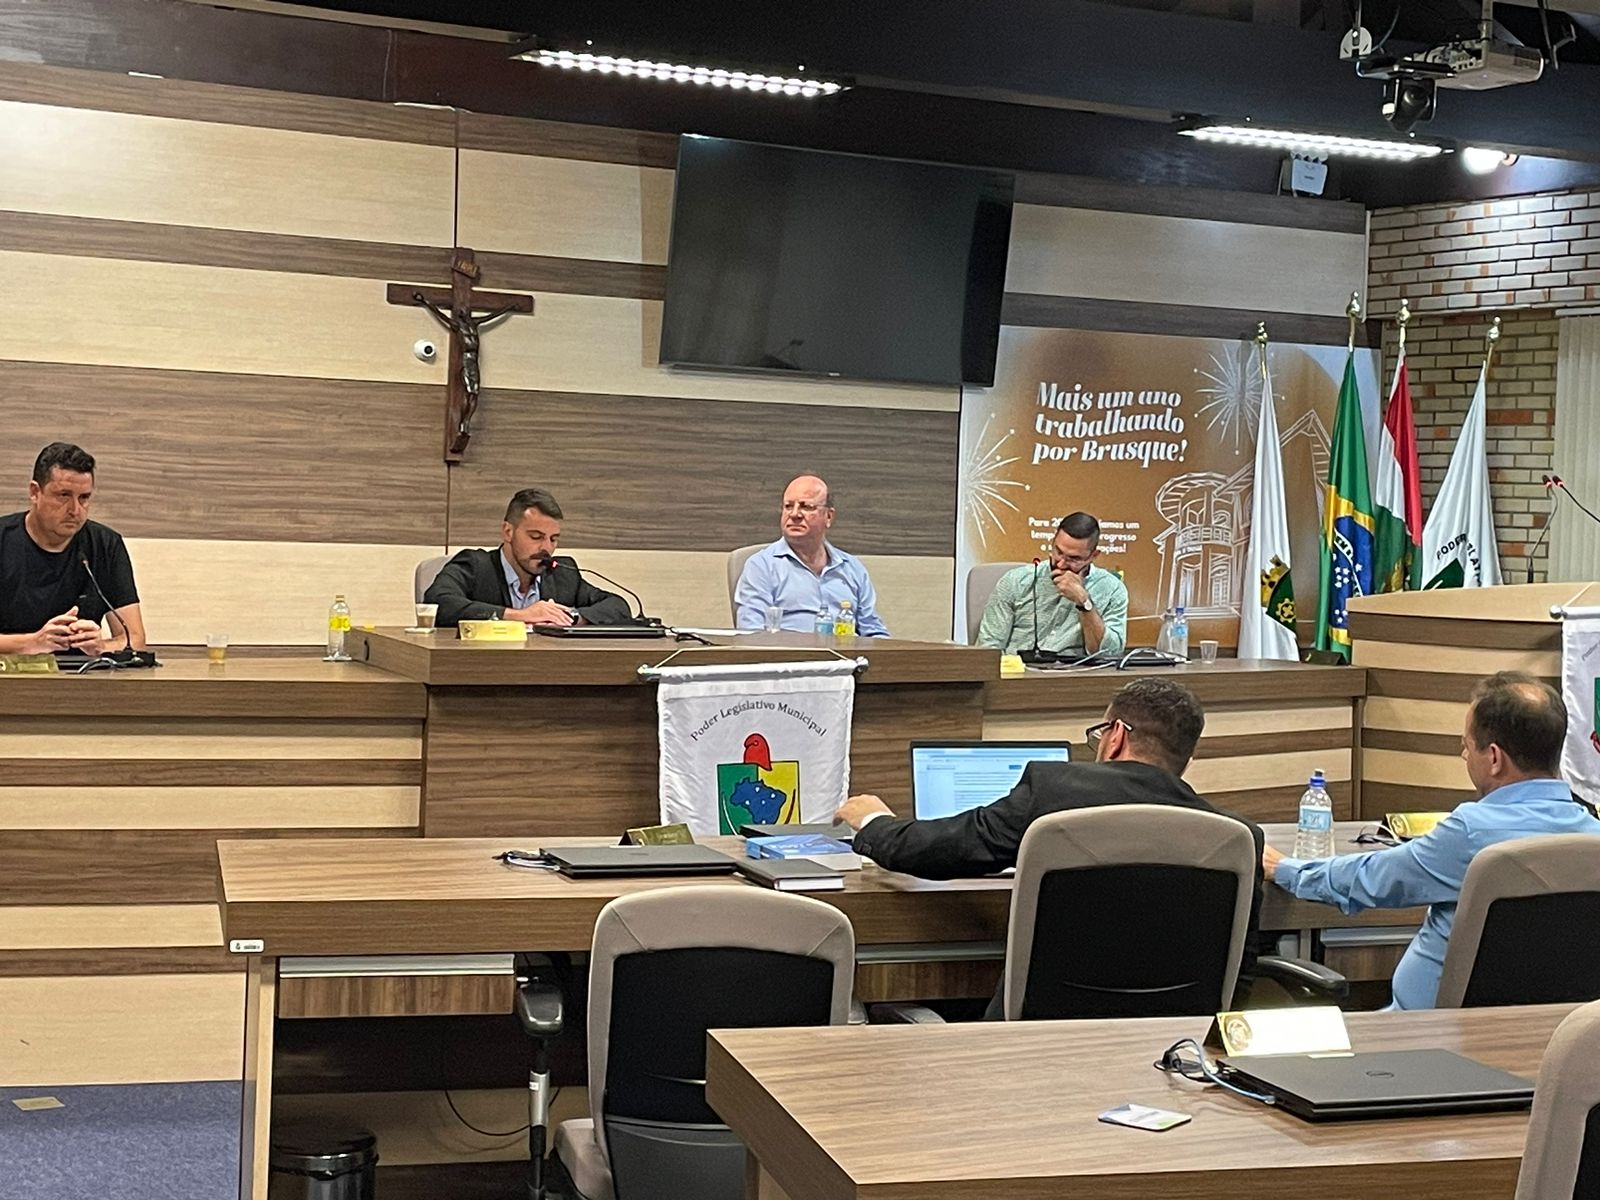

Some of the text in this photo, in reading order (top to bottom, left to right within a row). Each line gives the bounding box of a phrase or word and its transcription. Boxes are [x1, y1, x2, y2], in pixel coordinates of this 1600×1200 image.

[1036, 382, 1182, 411] Mais um ano
[1035, 407, 1185, 438] trabalhando
[1031, 439, 1188, 468] por Brusque!
[1028, 516, 1050, 527] Para
[1031, 529, 1137, 542] temp rogresso
[690, 700, 827, 741] Poder Legislativo Municipal
